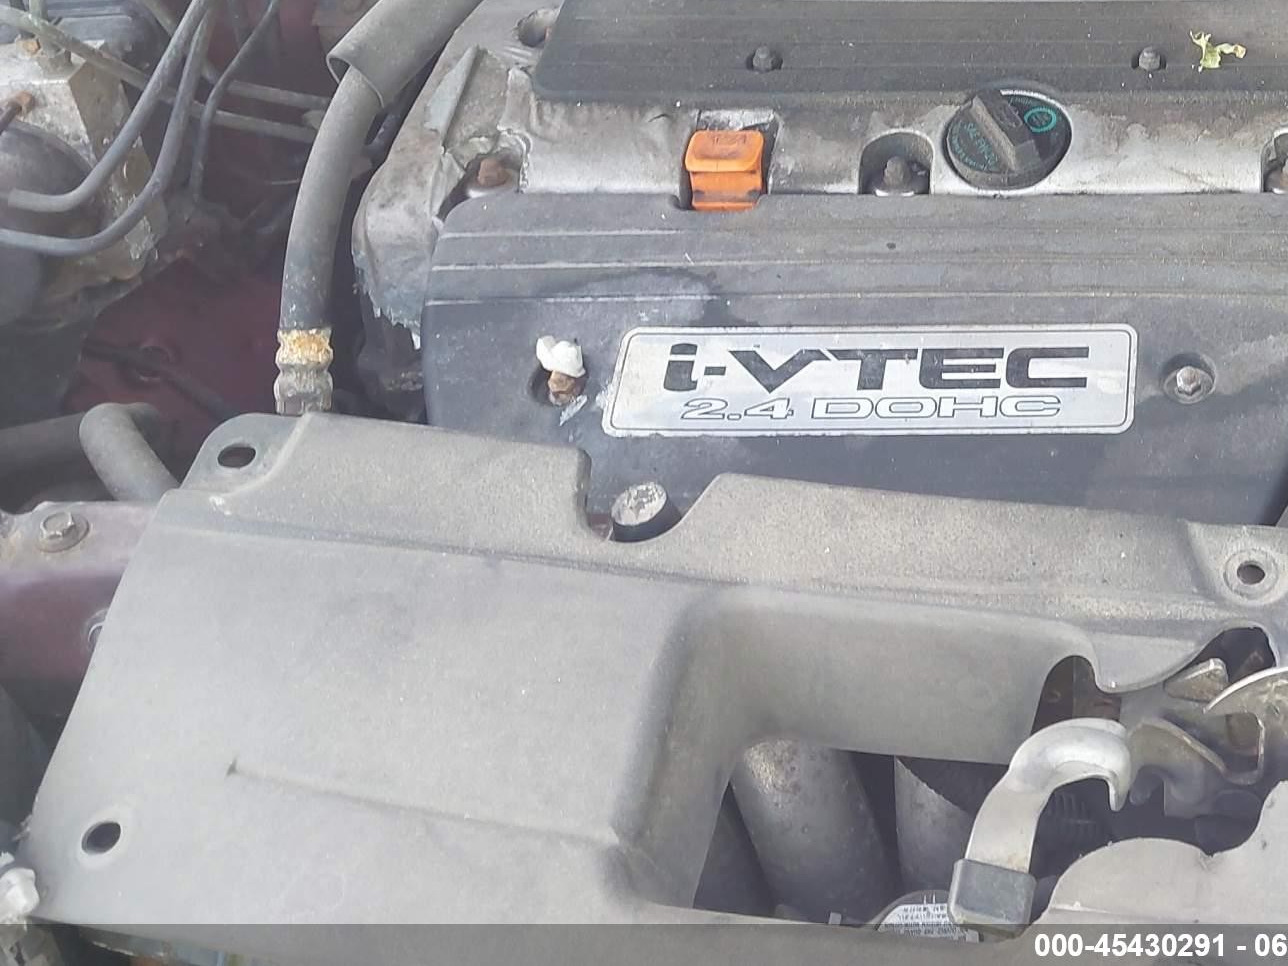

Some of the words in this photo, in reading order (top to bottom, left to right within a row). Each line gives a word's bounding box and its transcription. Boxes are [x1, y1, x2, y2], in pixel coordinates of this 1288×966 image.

[663, 343, 1090, 394] i-VTEC
[681, 397, 794, 420] 2.4
[811, 395, 1061, 419] DOHC
